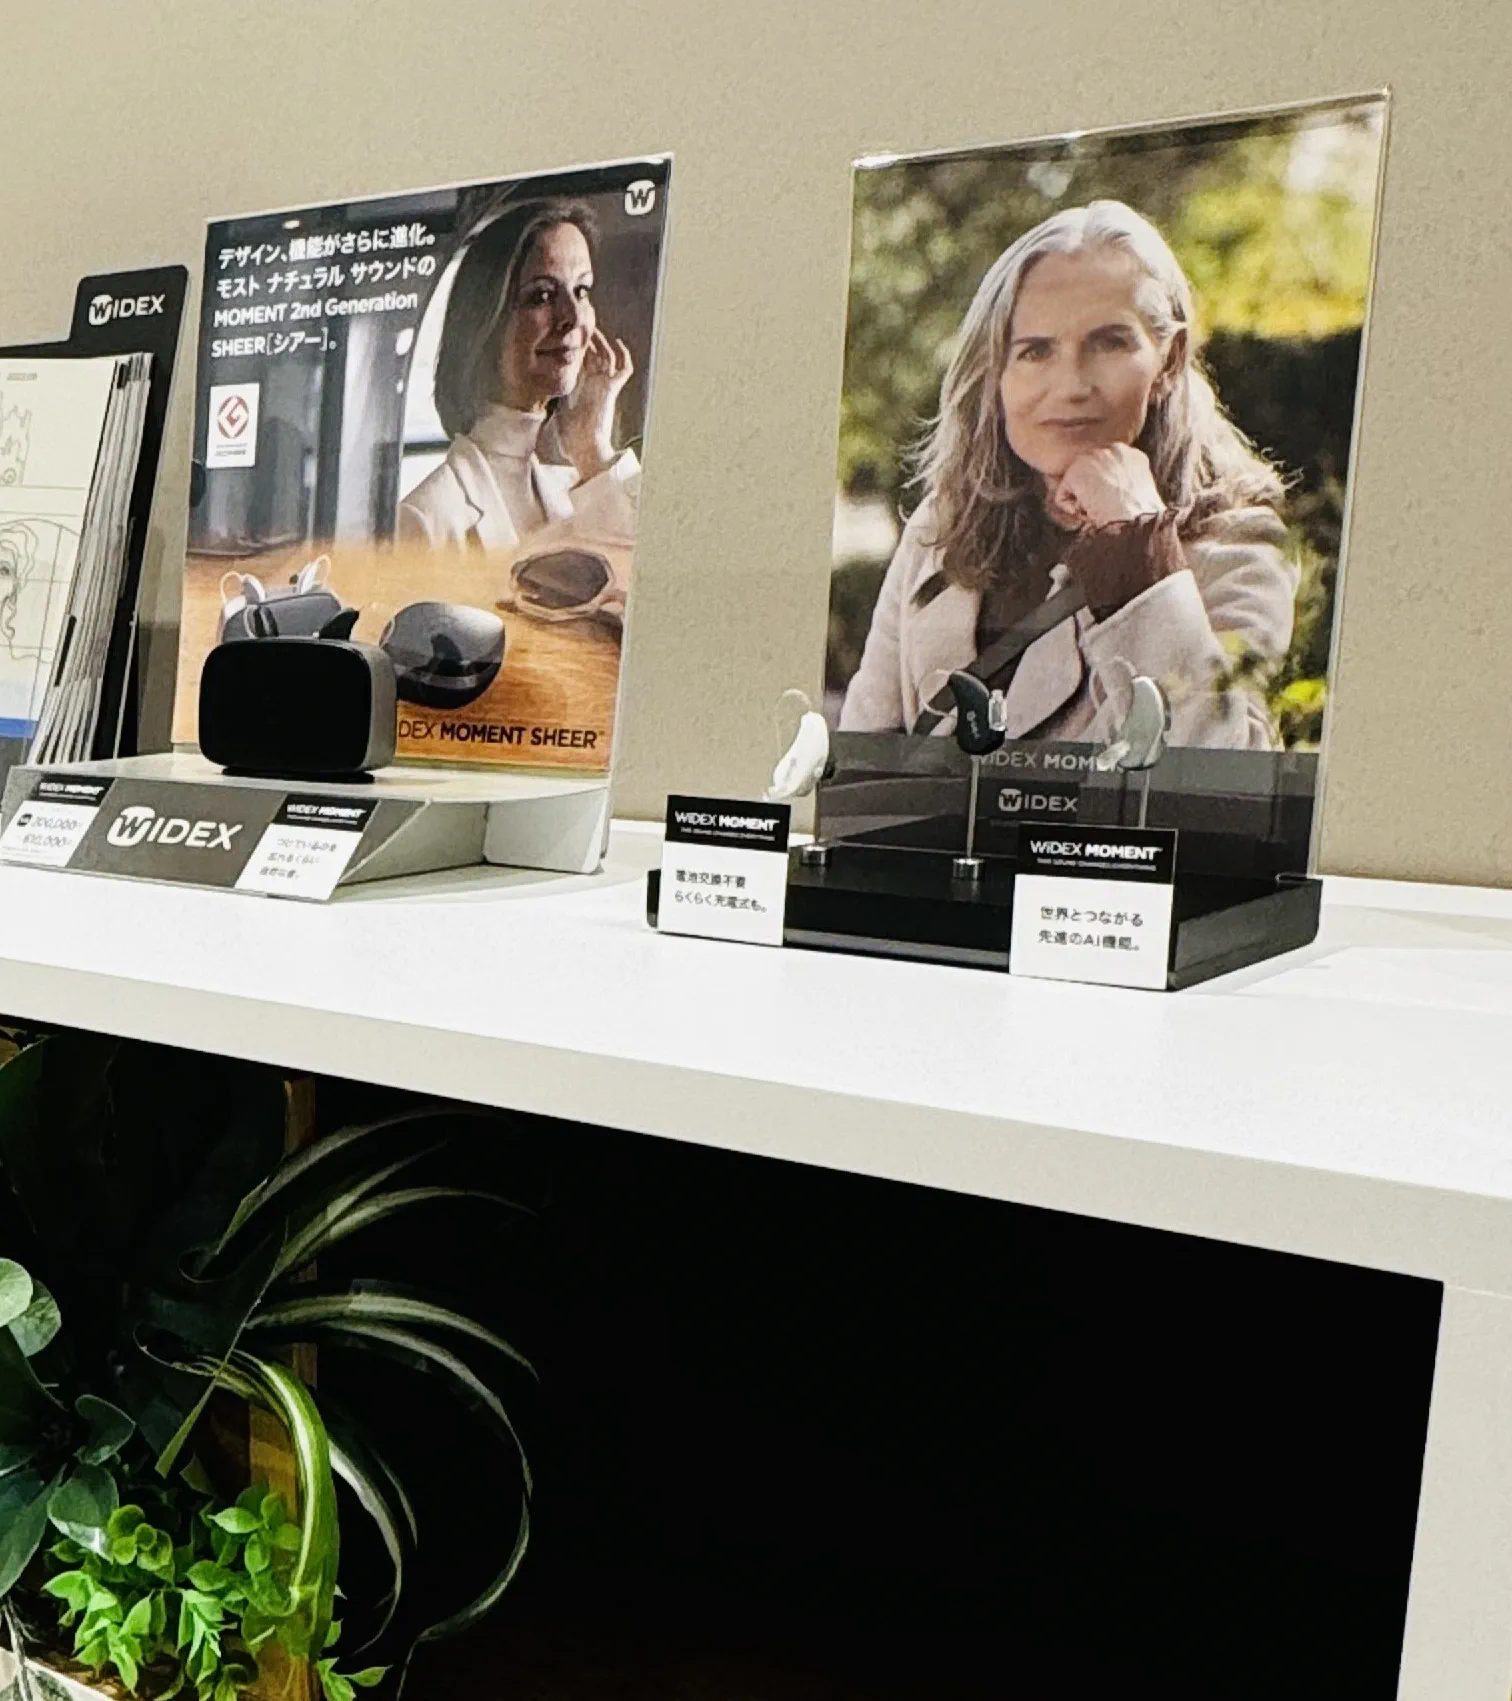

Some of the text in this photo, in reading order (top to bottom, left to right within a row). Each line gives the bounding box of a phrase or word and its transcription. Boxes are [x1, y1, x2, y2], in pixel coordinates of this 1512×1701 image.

[218, 222, 436, 270] デザイン、機能がさらに進化。
[216, 255, 436, 300] モスト ナチュラル サウンドの
[88, 294, 166, 326] WIDEX
[213, 291, 418, 328] MOMENT 2nd Generation
[397, 719, 598, 749] DEX MOMENT SHEER
[999, 788, 1079, 813] WIDEX
[106, 806, 243, 851] WIDEX
[674, 810, 776, 832] WIDEX MOMENT
[1030, 840, 1159, 861] WIDEX MOMENT
[1040, 905, 1144, 928] 世界とつながる
